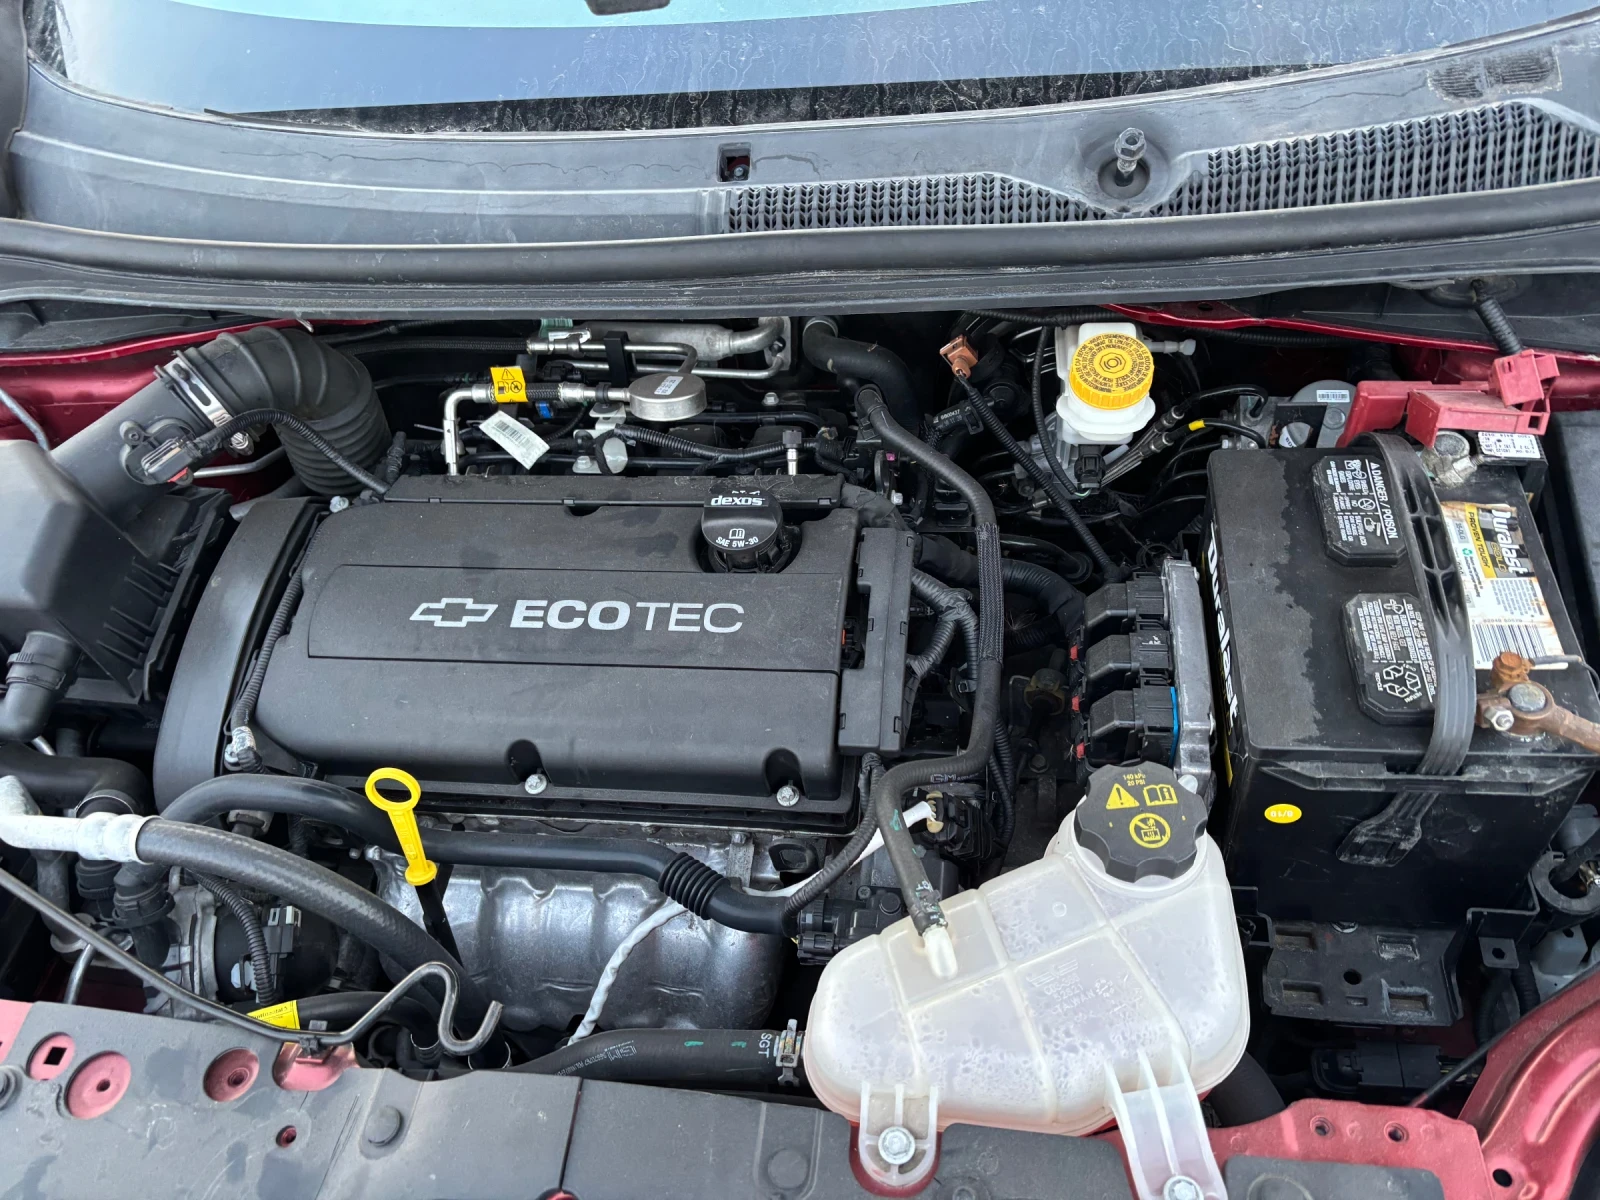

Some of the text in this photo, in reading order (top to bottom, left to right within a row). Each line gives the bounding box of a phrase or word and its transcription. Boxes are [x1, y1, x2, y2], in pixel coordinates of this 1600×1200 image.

[711, 495, 762, 506] dexos
[1371, 469, 1388, 500] DANGER
[1381, 509, 1398, 538] POISON
[716, 537, 759, 547] SAE 5W-30
[1467, 511, 1489, 566] PROVEN TOUGH
[1490, 542, 1508, 572] GOLD
[510, 600, 745, 633] ECOTEC
[1208, 523, 1238, 728] Duralast
[930, 773, 957, 784] GM
[758, 1033, 772, 1058] SGT
